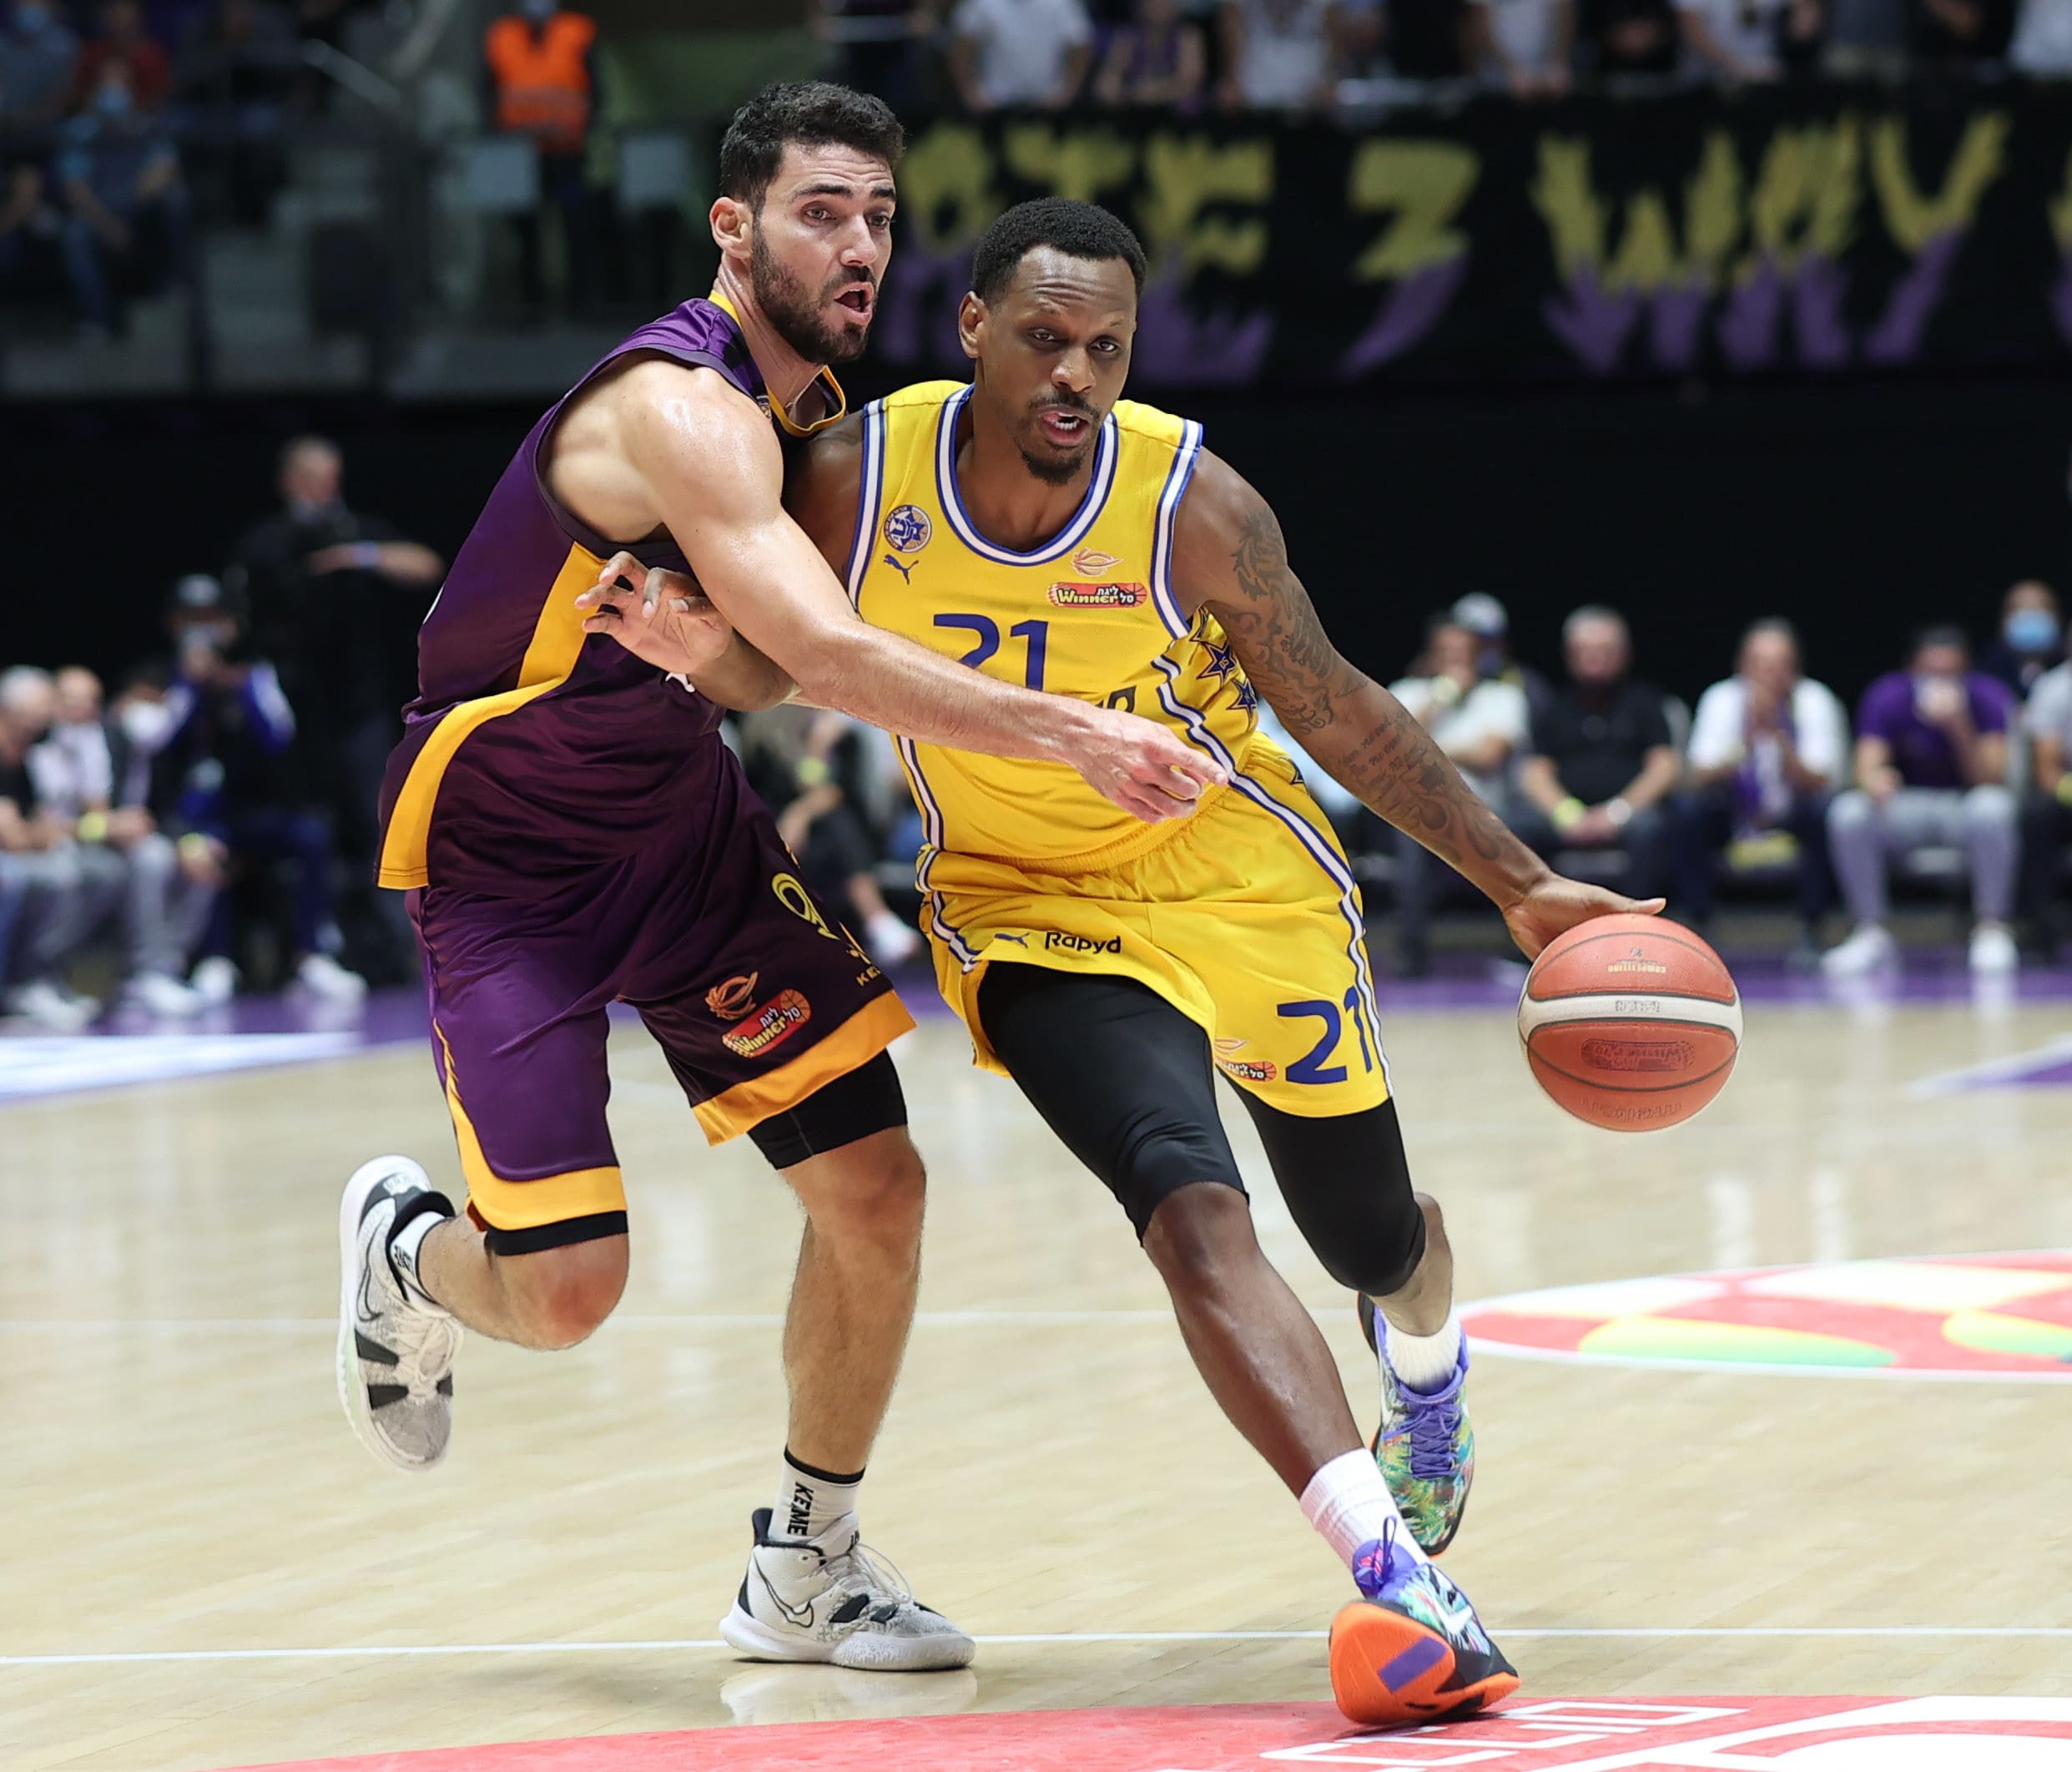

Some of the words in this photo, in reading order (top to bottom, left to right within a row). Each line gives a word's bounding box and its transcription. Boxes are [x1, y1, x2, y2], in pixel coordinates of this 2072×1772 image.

[1056, 588, 1118, 604] Winner
[933, 613, 1049, 691] 21
[1045, 931, 1122, 954] Rapyd
[1276, 986, 1374, 1084] 21
[787, 1482, 814, 1537] KEME
